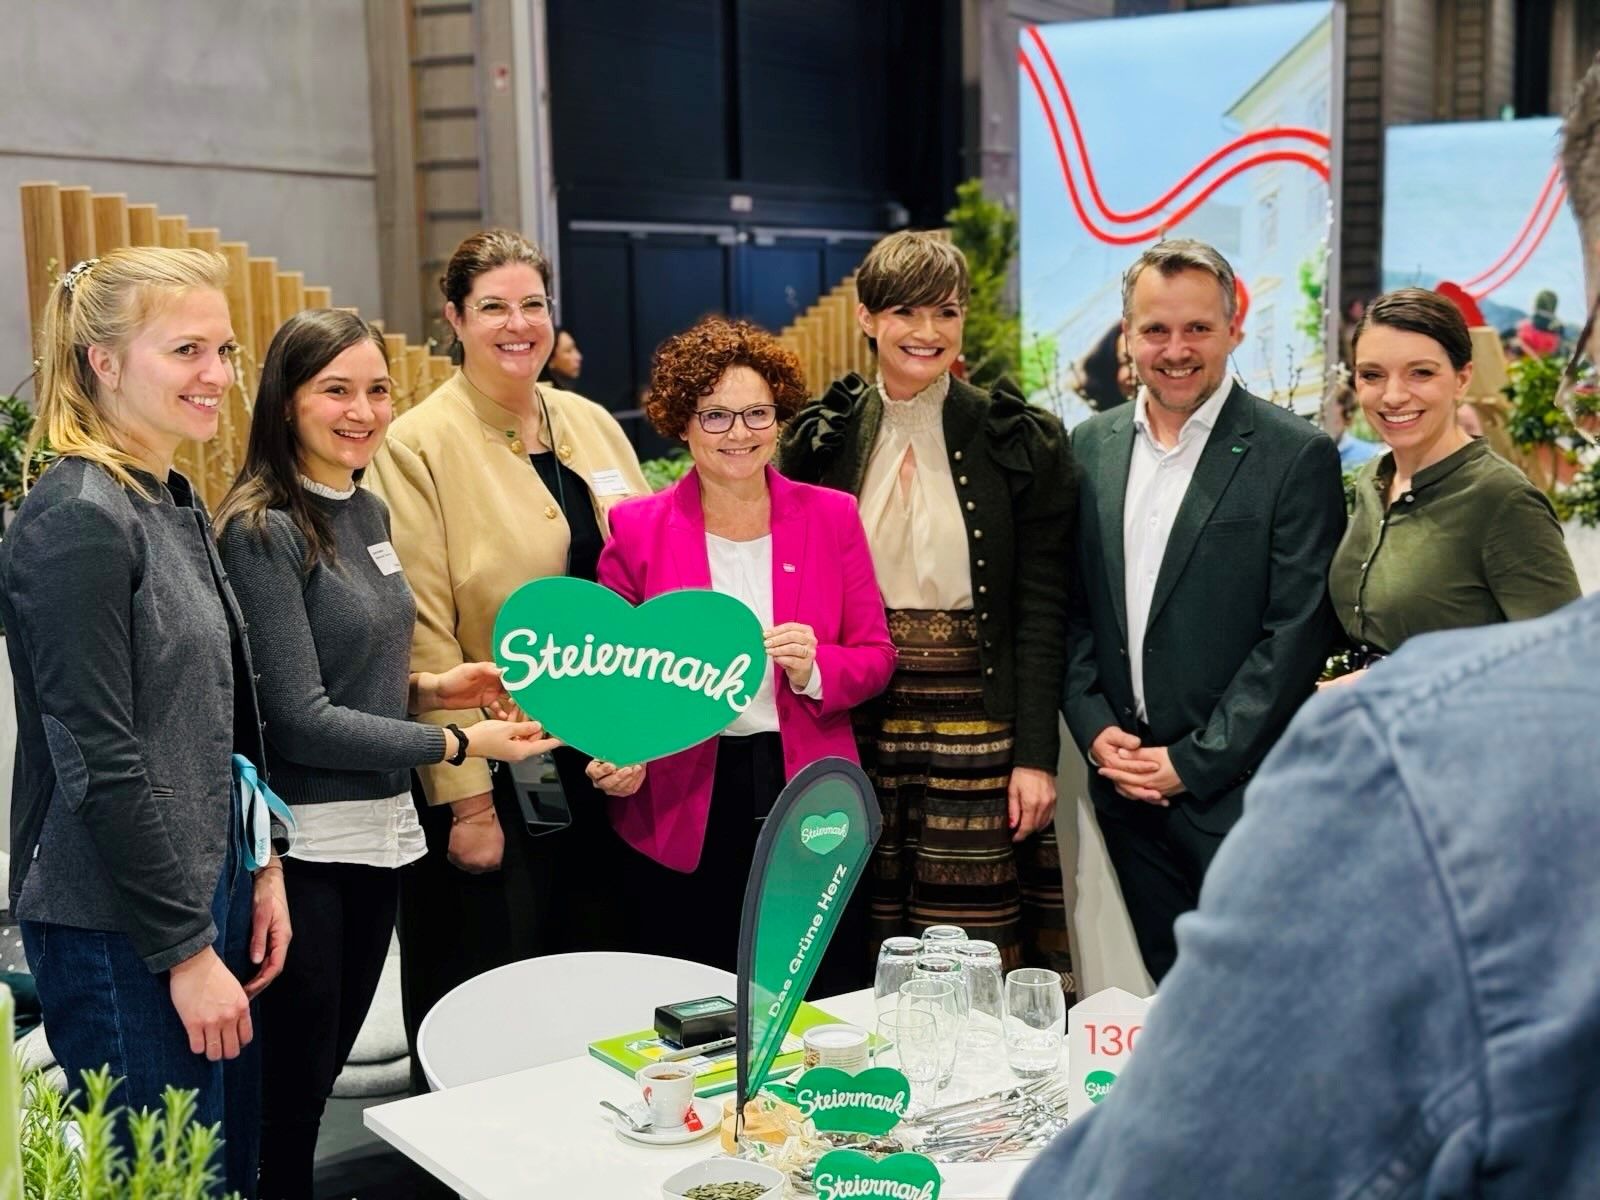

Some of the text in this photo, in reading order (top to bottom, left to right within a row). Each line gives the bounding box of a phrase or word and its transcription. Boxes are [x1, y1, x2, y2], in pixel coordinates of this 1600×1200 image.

[500, 629, 751, 712] Steiermark
[801, 824, 847, 843] Steiermark
[768, 863, 848, 1018] Das Grüne Herz
[797, 1089, 908, 1118] Steiermark
[816, 1173, 935, 1200] Steiermark
